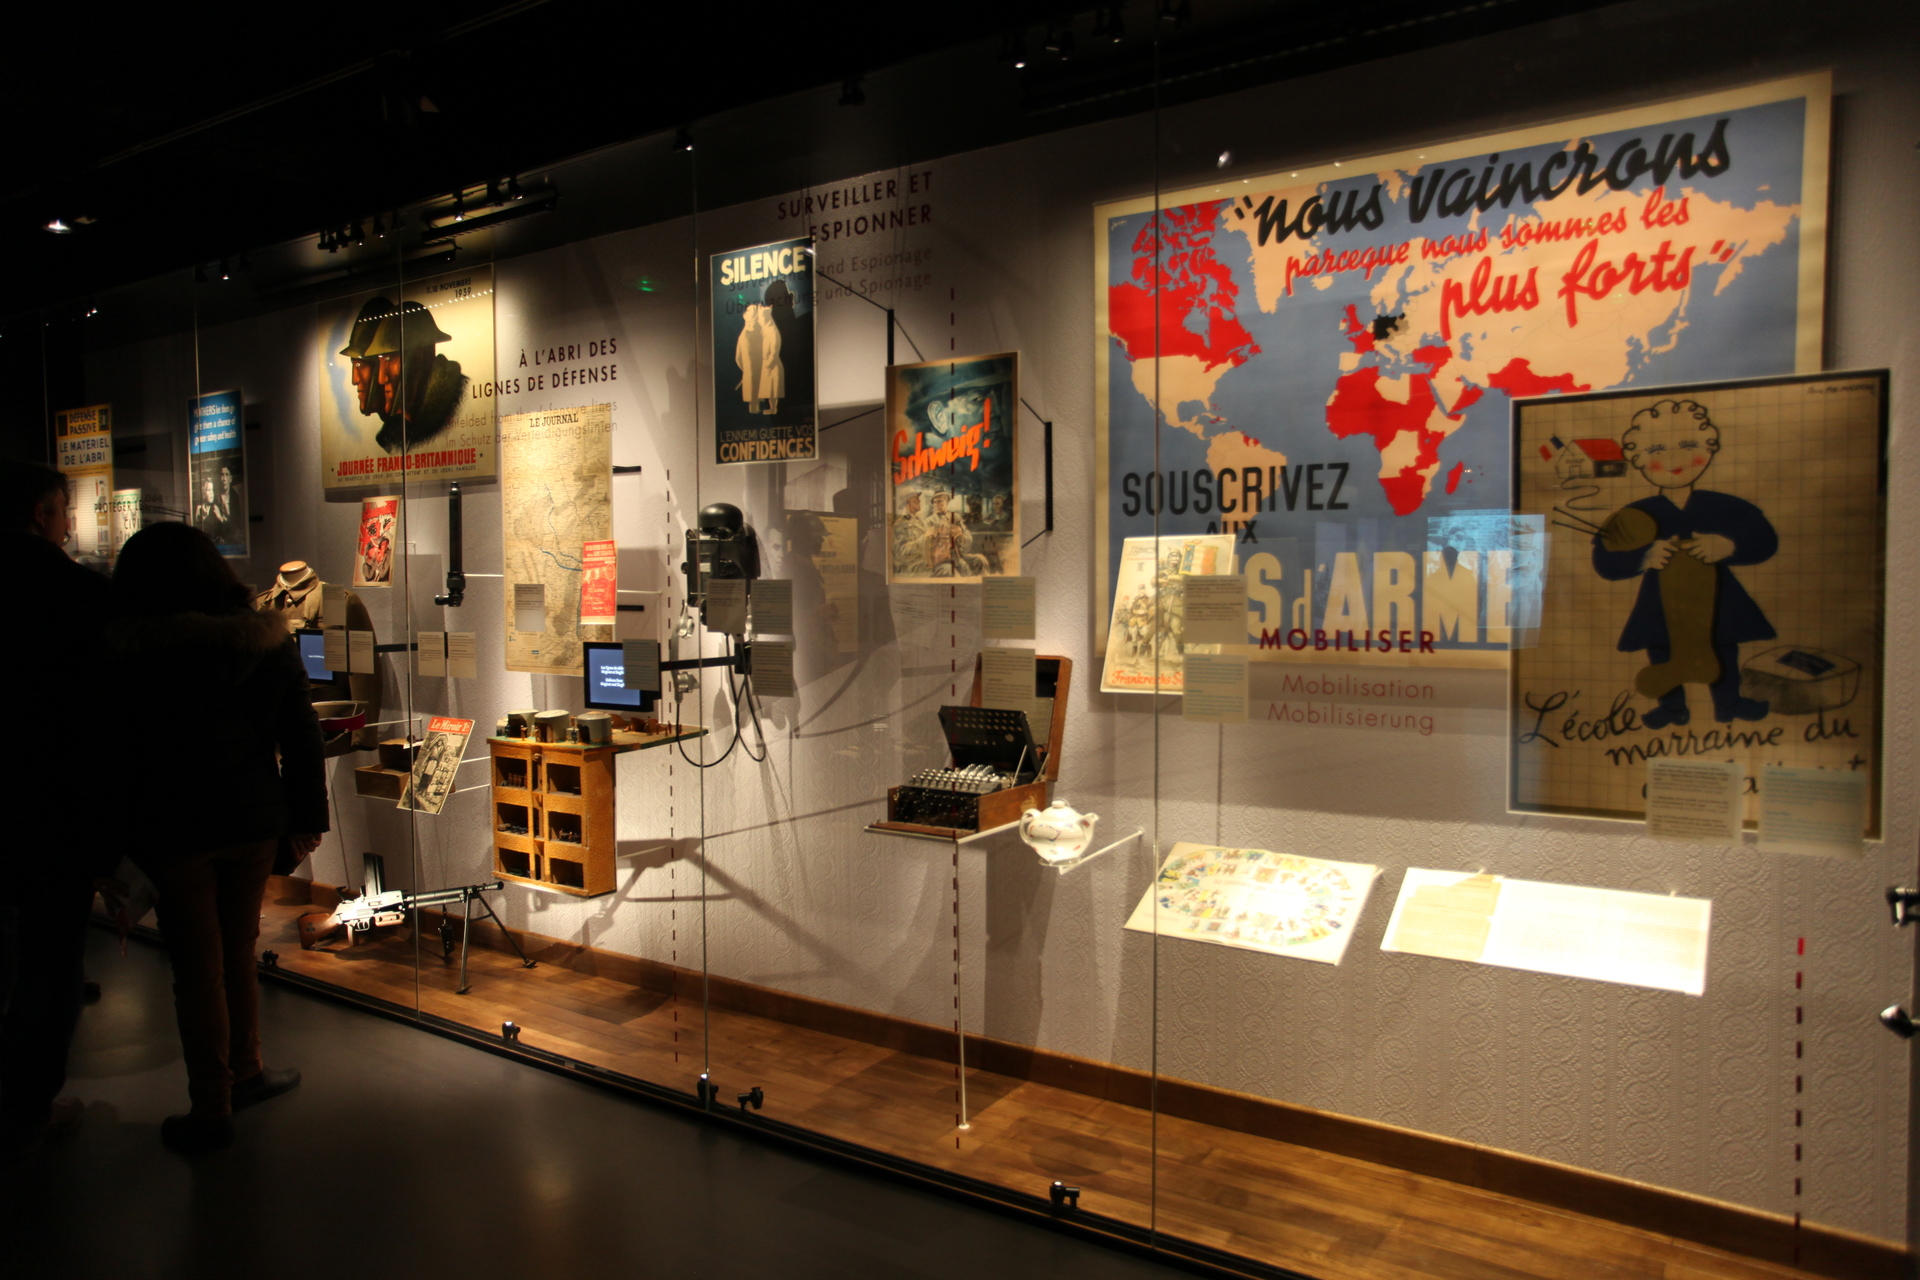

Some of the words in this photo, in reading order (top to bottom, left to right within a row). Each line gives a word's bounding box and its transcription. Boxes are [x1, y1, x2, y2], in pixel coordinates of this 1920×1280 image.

[1408, 117, 1731, 223] vaincrons
[778, 180, 896, 220] SURVEILLER
[910, 172, 931, 194] ET
[809, 204, 931, 243] ESPIONNER
[1285, 239, 1410, 296] parceque
[1421, 226, 1487, 259] nous
[1499, 206, 1627, 248] sommes
[1640, 185, 1690, 230] les
[720, 245, 806, 286] SILENCE
[817, 258, 844, 277] and
[851, 248, 932, 273] Espionage
[440, 277, 471, 291] NOVEMBRE
[455, 287, 471, 298] 1939
[825, 280, 852, 300] und
[860, 273, 931, 298] Spionage
[1438, 256, 1540, 343] plus
[519, 348, 528, 368] À
[535, 343, 581, 365] L'ABRI
[589, 338, 617, 357] DES
[472, 378, 520, 399] LIGNES
[528, 375, 544, 391] DE
[552, 364, 617, 388] DÉFENSE
[69, 410, 97, 424] DÉFENSE
[446, 411, 487, 430] Shielded
[490, 410, 512, 425] from
[516, 407, 532, 422] the
[537, 402, 587, 420] defensive
[591, 398, 617, 413] lines
[530, 418, 540, 428] LE
[541, 413, 579, 427] JOURNAL
[70, 423, 97, 435] PASSIVE
[445, 436, 456, 448] Im
[460, 431, 491, 447] Schutz
[495, 429, 511, 444] der
[515, 418, 618, 442] Verteidigungslinien
[719, 429, 758, 443] L'ENNEMI
[759, 426, 794, 440] GUETTE
[795, 424, 814, 437] VOS
[892, 397, 991, 485] Schweig!
[59, 442, 69, 453] LE
[70, 438, 109, 452] MATÉRIEL
[64, 455, 76, 466] DE
[79, 451, 106, 464] L'ABRI
[719, 436, 814, 463] CONFIDENCES
[337, 455, 374, 477] JOURNÉE
[1121, 462, 1350, 517] SOUSCRIVEZ
[1259, 626, 1436, 654] MOBILISER
[1112, 670, 1171, 685] Frankrechs
[1281, 672, 1435, 700] Mobilisation
[430, 718, 441, 729] Le
[440, 719, 463, 732] Miroir
[1267, 702, 1435, 736] Mobilisierung
[1519, 690, 1642, 748] L'école
[1606, 724, 1784, 768] marraine
[1804, 704, 1861, 745] du
